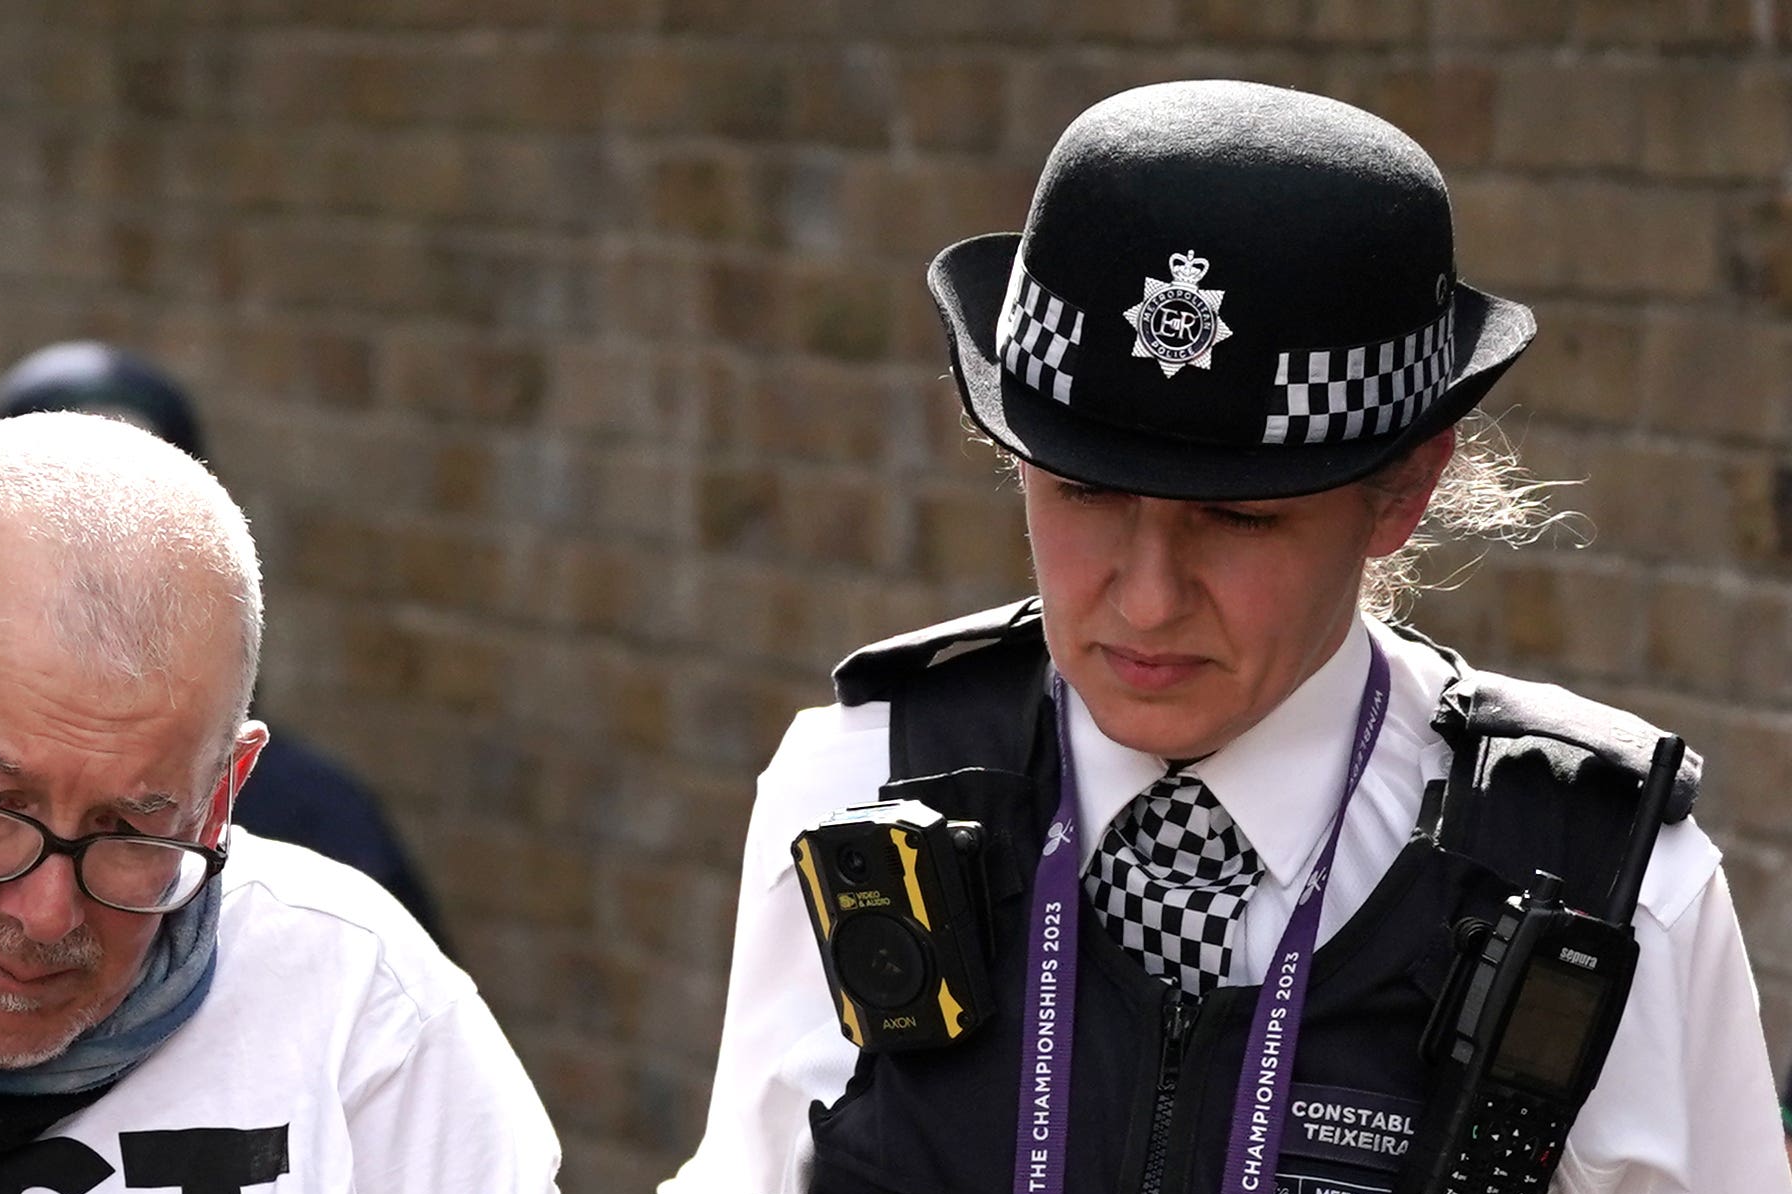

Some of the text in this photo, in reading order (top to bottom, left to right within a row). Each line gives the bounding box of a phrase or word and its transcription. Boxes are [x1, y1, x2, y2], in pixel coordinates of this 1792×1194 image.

[1151, 341, 1195, 359] POLICE
[1560, 947, 1598, 969] sepura
[882, 1016, 917, 1030] AXON
[1029, 902, 1062, 1192] THE CHAMPIONSHIPS 2023
[1241, 1006, 1287, 1191] CHAMPIONSHIPS
[1276, 951, 1300, 1001] 2023
[1291, 1100, 1415, 1135] CONSTABL
